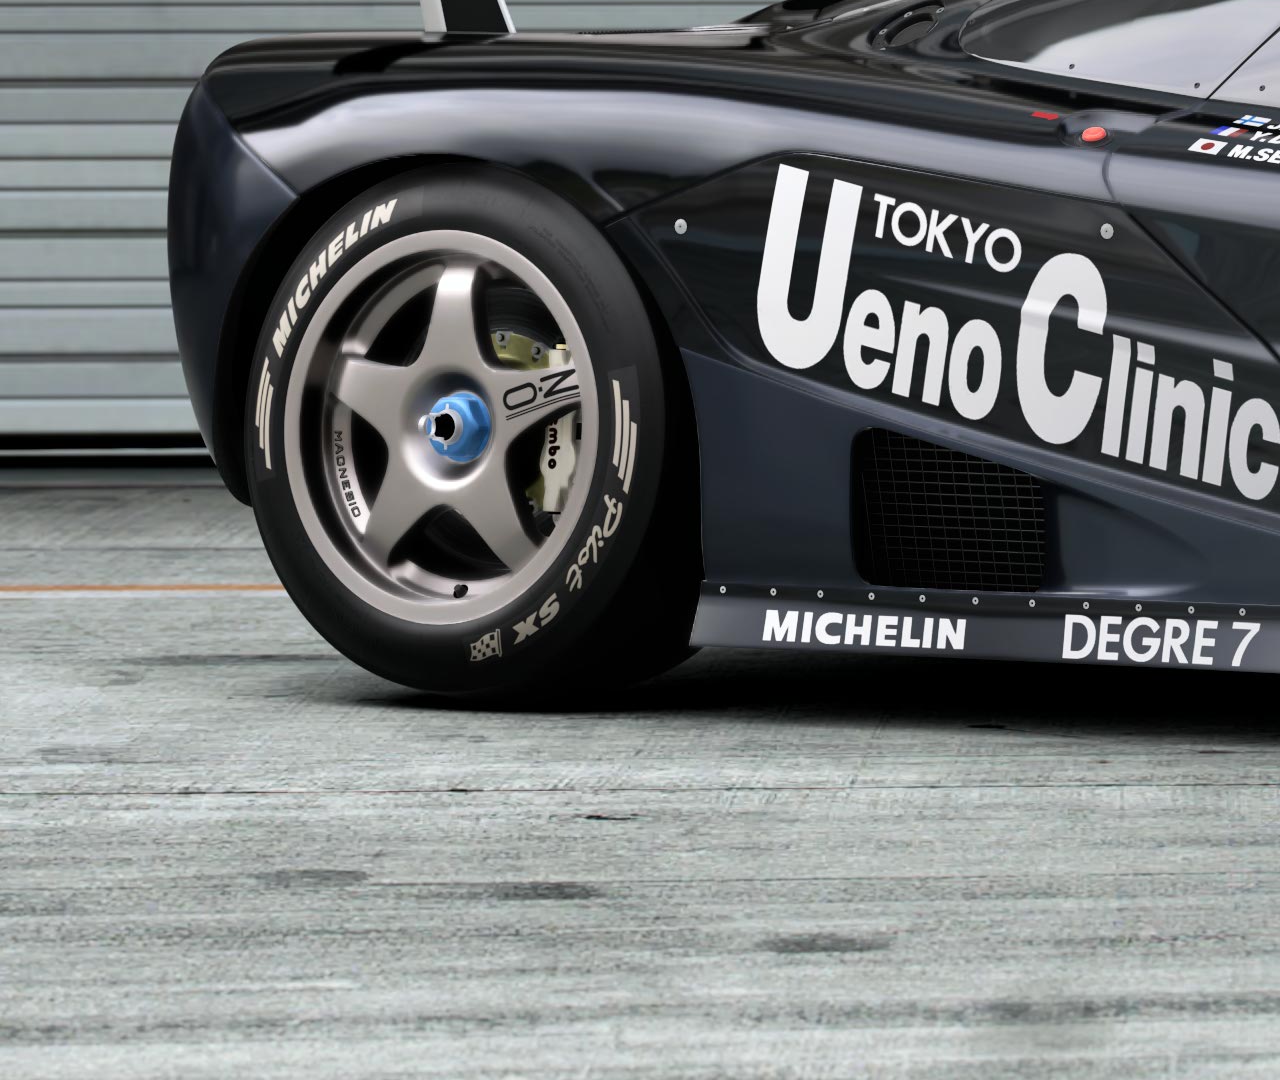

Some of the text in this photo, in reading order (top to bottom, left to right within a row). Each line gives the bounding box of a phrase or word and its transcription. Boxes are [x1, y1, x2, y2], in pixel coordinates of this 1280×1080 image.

[272, 198, 398, 358] MICHELIN
[873, 193, 1022, 273] TOKYO
[757, 164, 1002, 421] Ueno
[512, 494, 623, 645] Pilot SX
[762, 609, 967, 651] MICHELIN
[1062, 614, 1261, 668] DEGRE 7
